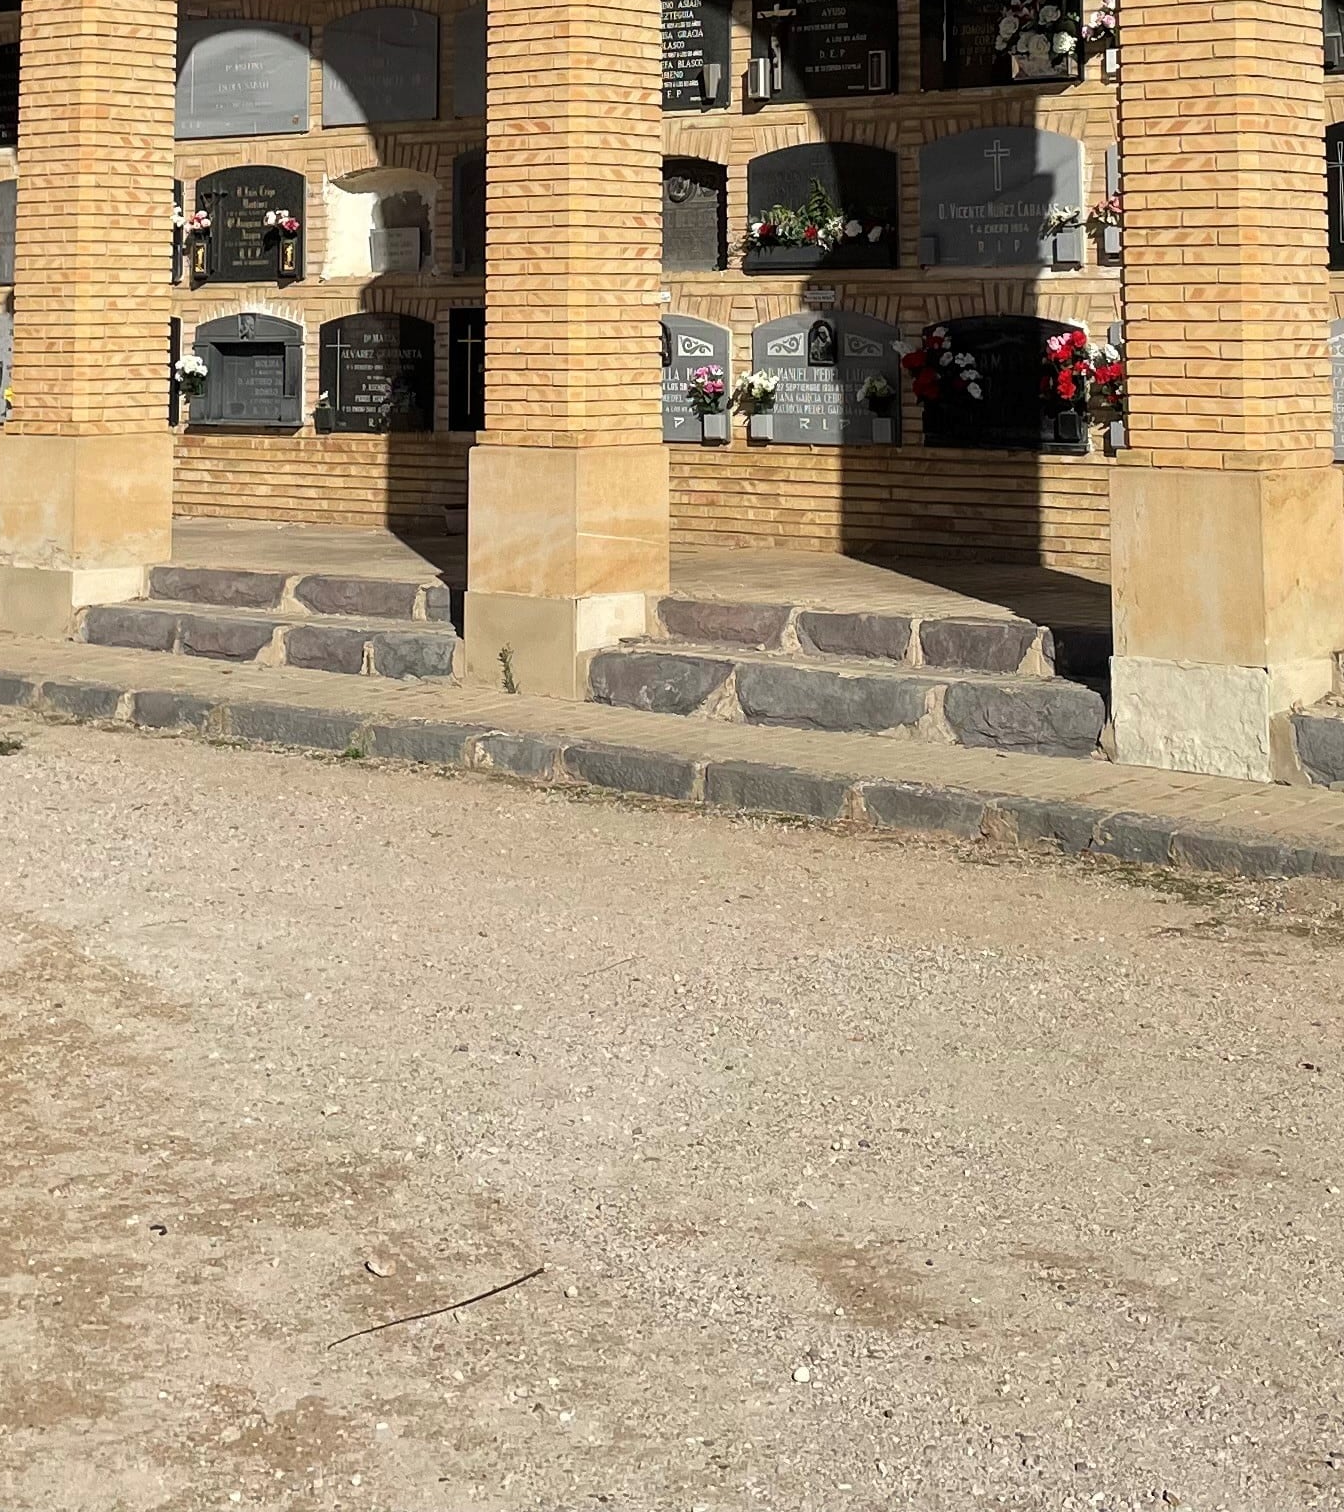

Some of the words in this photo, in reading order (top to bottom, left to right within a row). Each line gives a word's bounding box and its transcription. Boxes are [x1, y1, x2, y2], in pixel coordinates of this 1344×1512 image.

[949, 202, 985, 219] VICENTE
[777, 368, 807, 382] MANUEL
[799, 418, 810, 429] R
